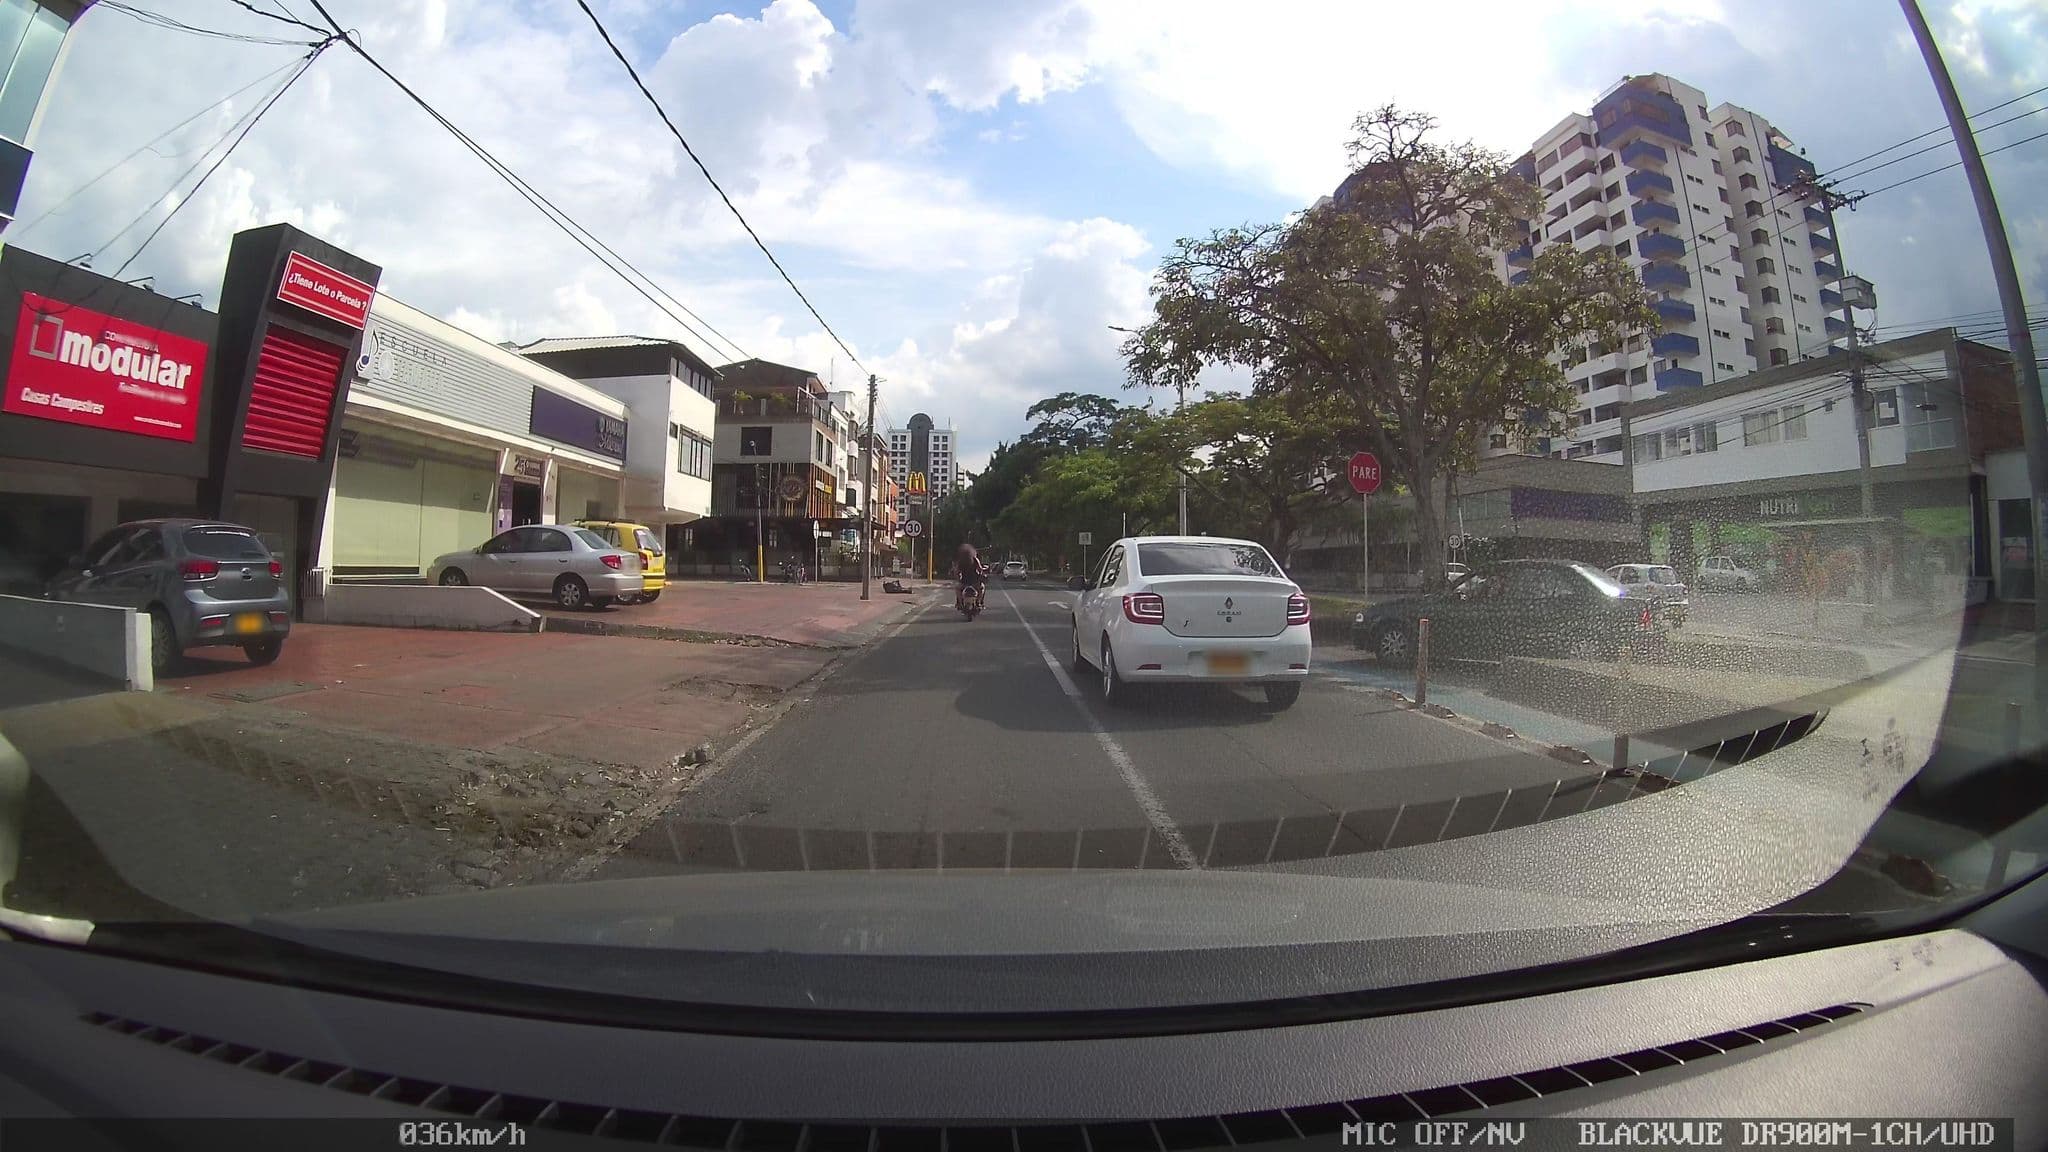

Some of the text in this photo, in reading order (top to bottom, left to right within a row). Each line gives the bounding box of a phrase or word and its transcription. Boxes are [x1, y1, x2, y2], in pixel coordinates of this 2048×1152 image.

[288, 273, 314, 289] ¿Tiene
[314, 281, 330, 296] Lote
[336, 290, 362, 308] Parcela
[61, 330, 192, 389] modular
[379, 331, 448, 367] ESCUELA
[21, 387, 51, 405] Casas
[1352, 465, 1377, 480] PARE
[907, 523, 920, 534] 30
